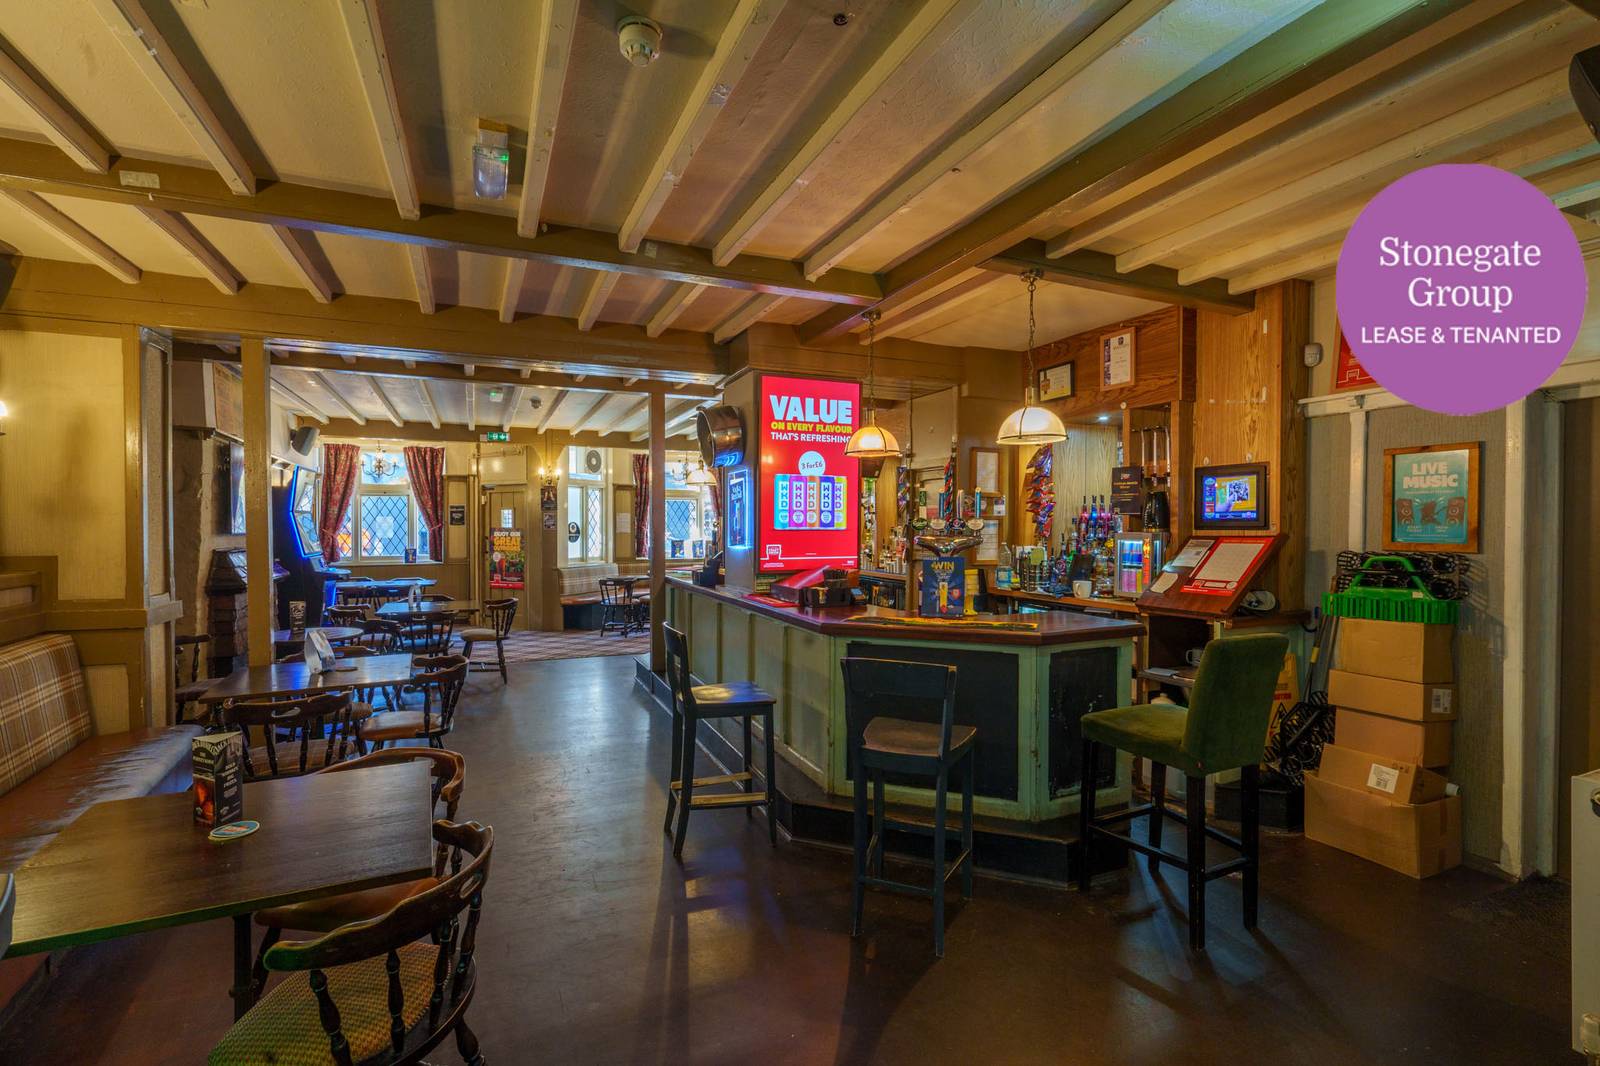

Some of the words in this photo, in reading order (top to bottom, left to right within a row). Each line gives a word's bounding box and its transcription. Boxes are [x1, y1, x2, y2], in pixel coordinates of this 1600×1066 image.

[769, 394, 853, 424] VALUE
[771, 421, 785, 431] ON
[786, 422, 814, 432] EVERY
[816, 424, 852, 434] FLAVOUR
[770, 432, 799, 441] THAT'S
[1411, 462, 1448, 475] LIVE
[1403, 474, 1458, 489] MUSIC
[934, 561, 955, 570] WIN
